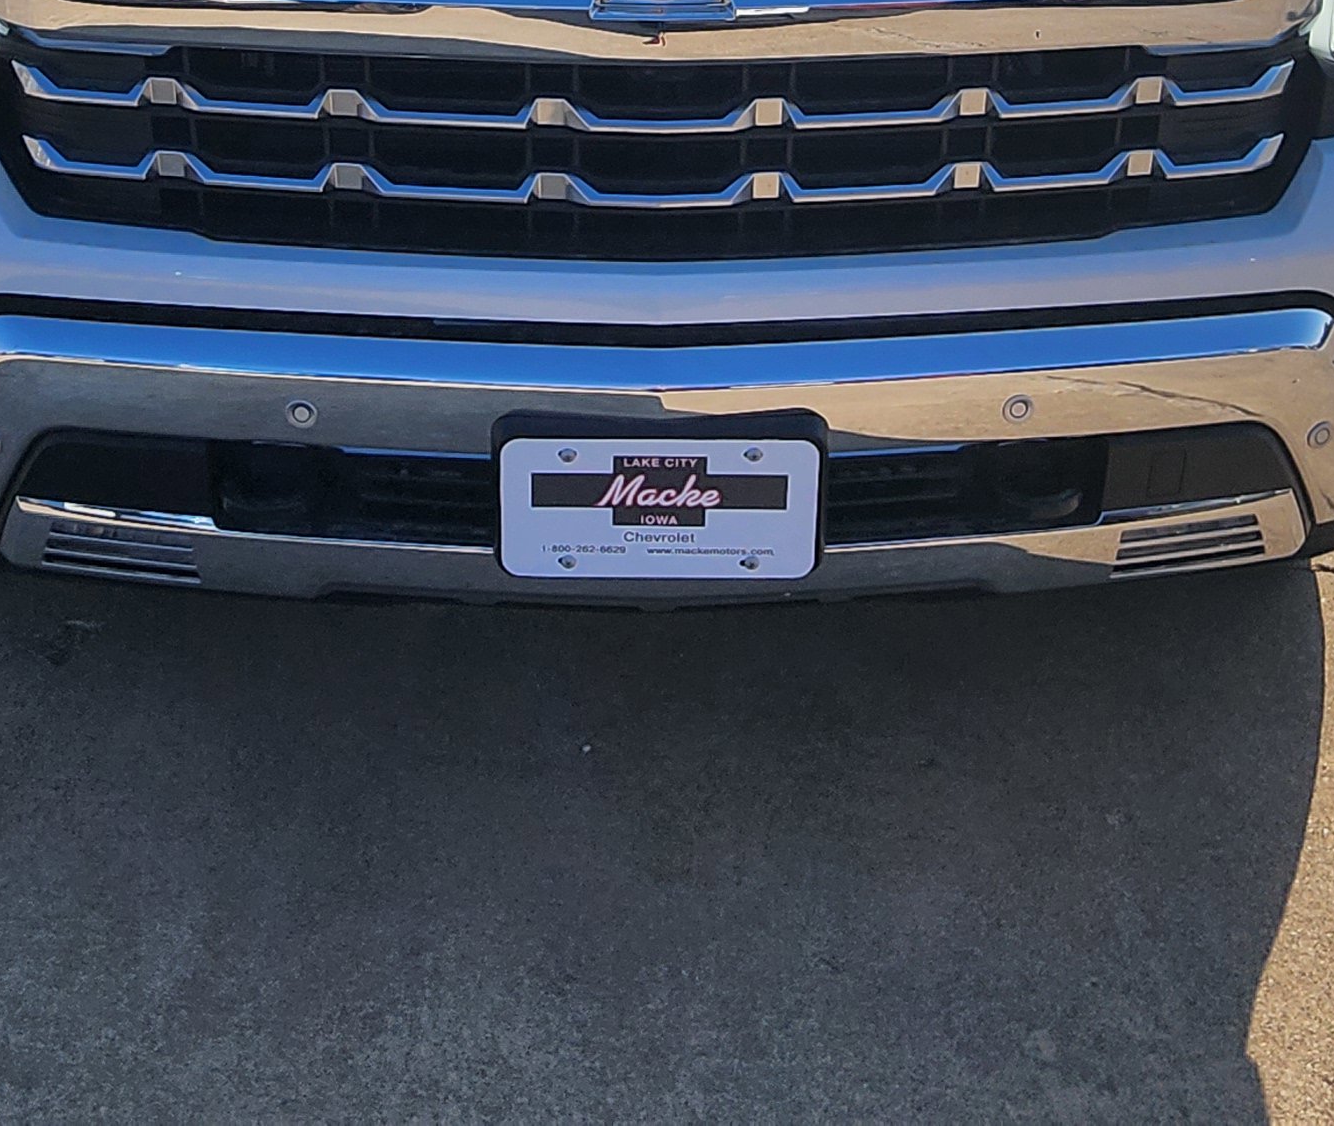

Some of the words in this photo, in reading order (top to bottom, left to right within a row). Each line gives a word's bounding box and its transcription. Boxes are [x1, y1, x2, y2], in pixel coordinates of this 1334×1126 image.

[623, 458, 660, 468] LAKE
[664, 458, 698, 468] CITY
[597, 474, 722, 507] Macke
[640, 515, 678, 525] IOWA
[623, 531, 695, 543] Chevrolet
